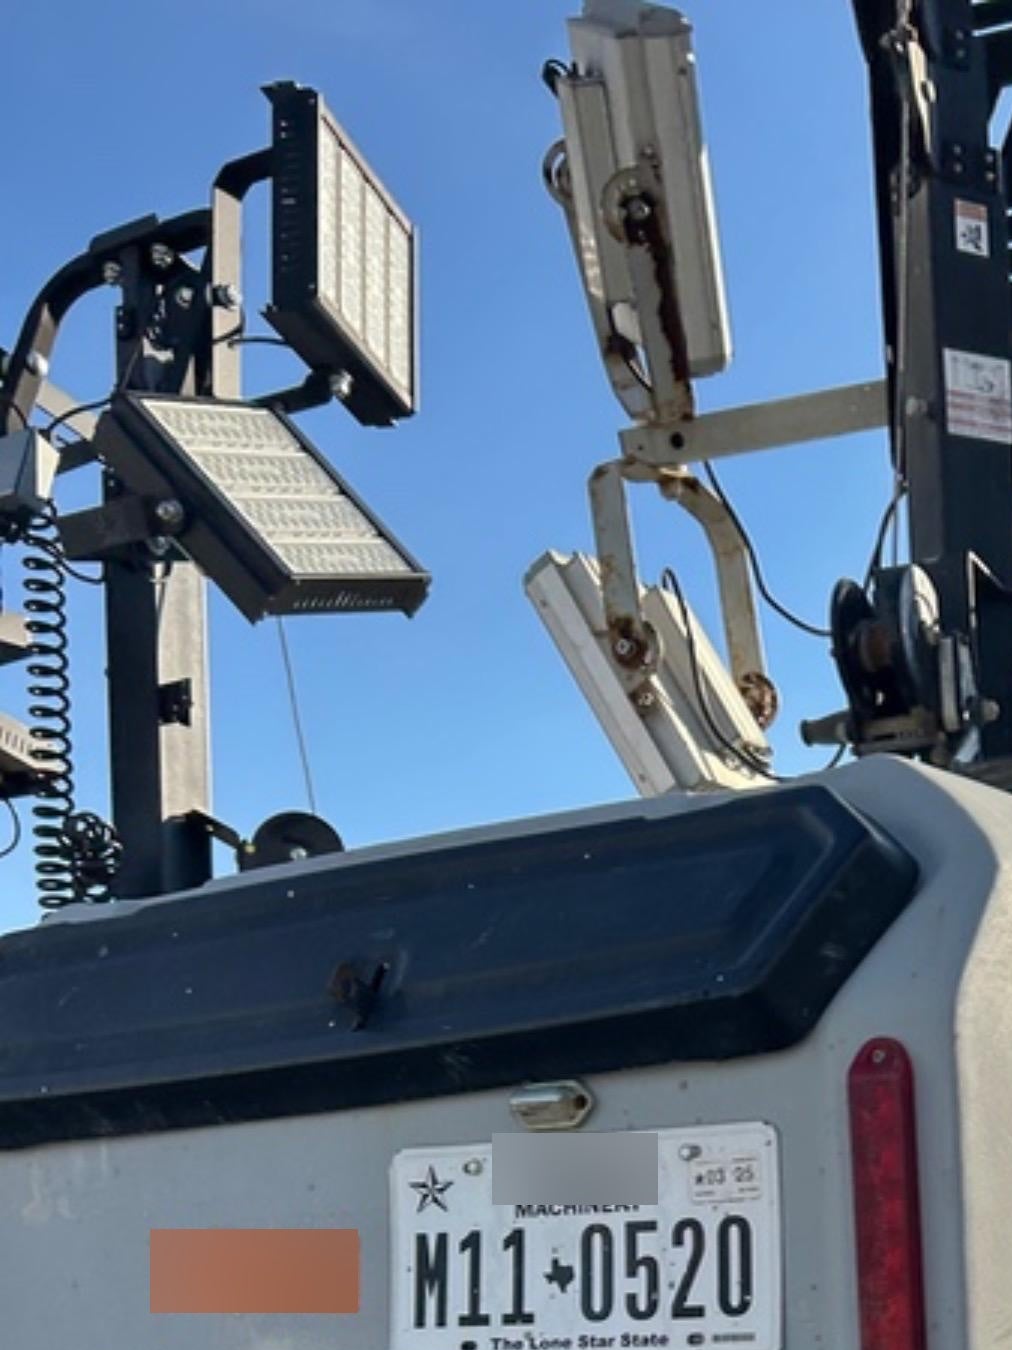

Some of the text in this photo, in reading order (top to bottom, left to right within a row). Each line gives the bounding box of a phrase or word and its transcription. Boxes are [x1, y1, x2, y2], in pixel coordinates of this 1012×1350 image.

[414, 1215, 753, 1329] M11 0520
[490, 1332, 669, 1350] The Lone Star State
